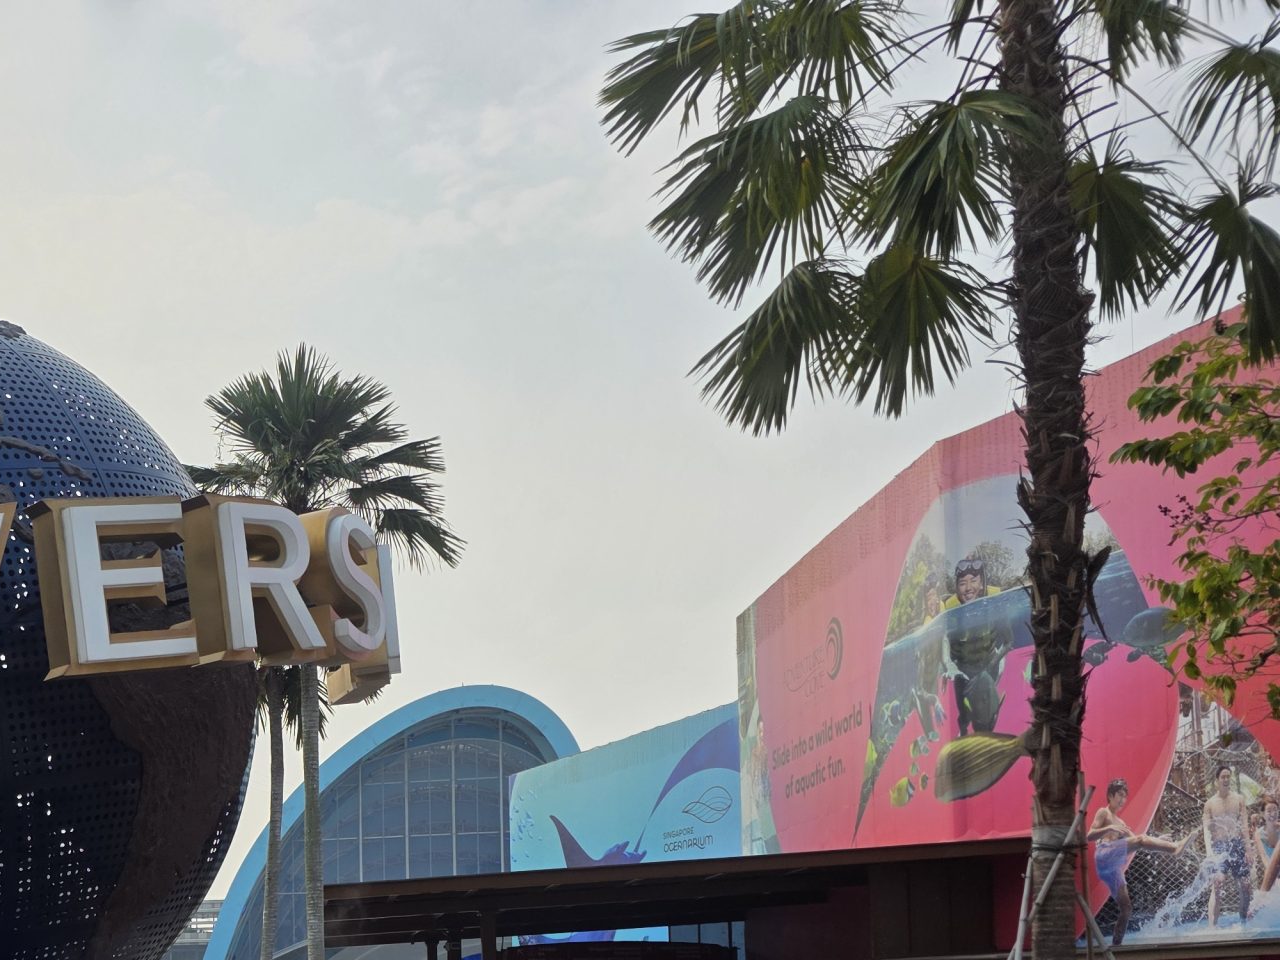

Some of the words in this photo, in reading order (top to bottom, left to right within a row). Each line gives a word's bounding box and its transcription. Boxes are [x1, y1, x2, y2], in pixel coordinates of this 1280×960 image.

[772, 743, 791, 770] Slide
[791, 736, 808, 763] into
[815, 716, 833, 749] wild
[834, 702, 863, 737] world
[785, 776, 795, 799] of
[795, 763, 826, 798] aquatic
[827, 755, 846, 780] fun.
[663, 826, 694, 840] SINGAPORE
[663, 835, 714, 853] OCEANARIUM
